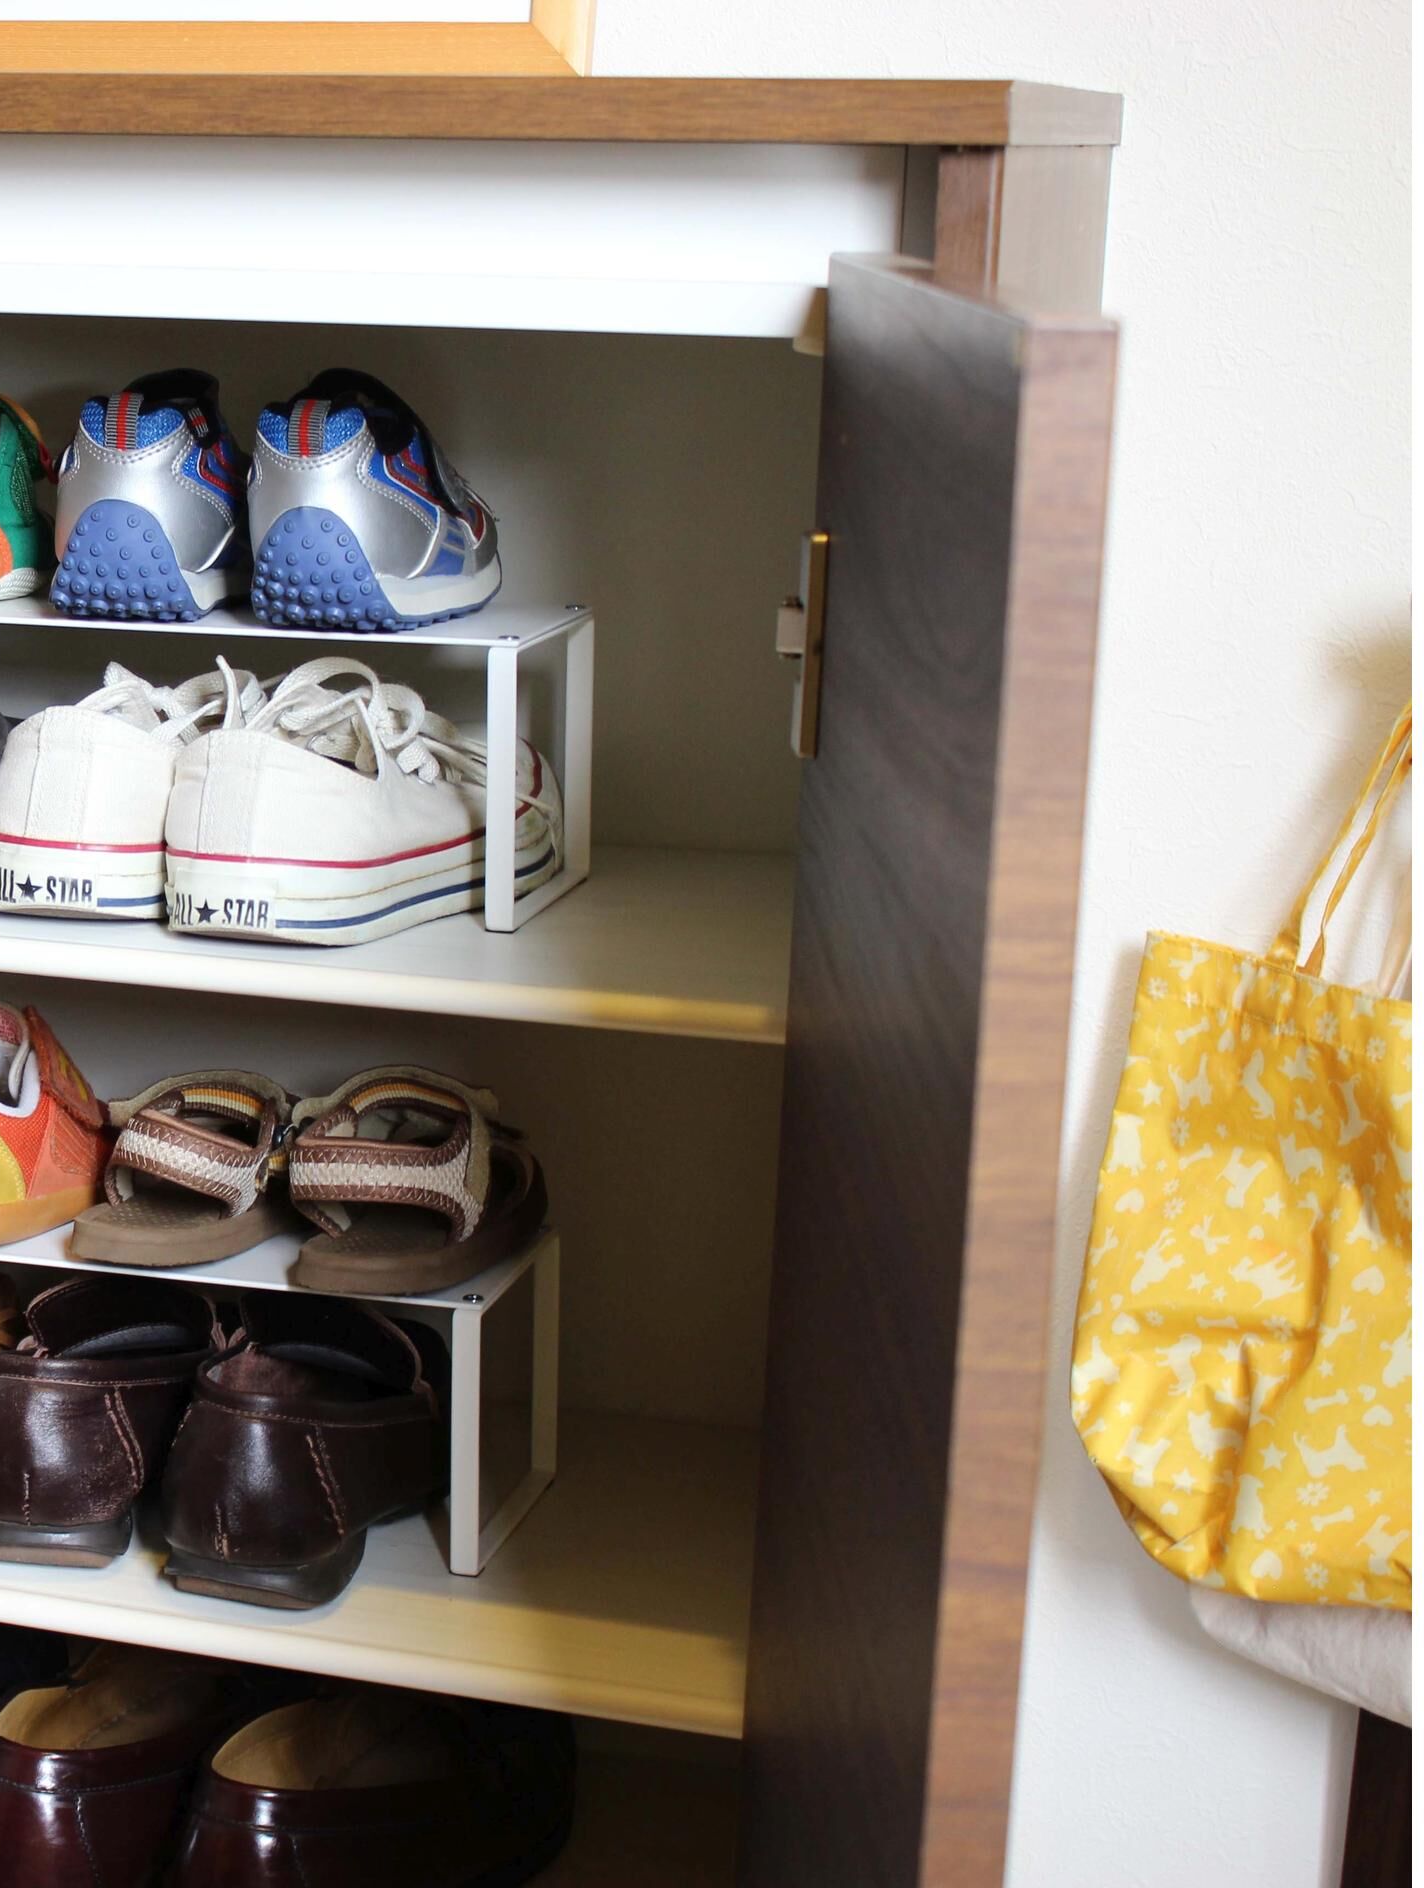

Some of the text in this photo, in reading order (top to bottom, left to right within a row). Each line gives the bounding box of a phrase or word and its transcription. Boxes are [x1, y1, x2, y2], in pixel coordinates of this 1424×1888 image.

[45, 875, 94, 903] STAR
[173, 891, 270, 929] ALL STAR
